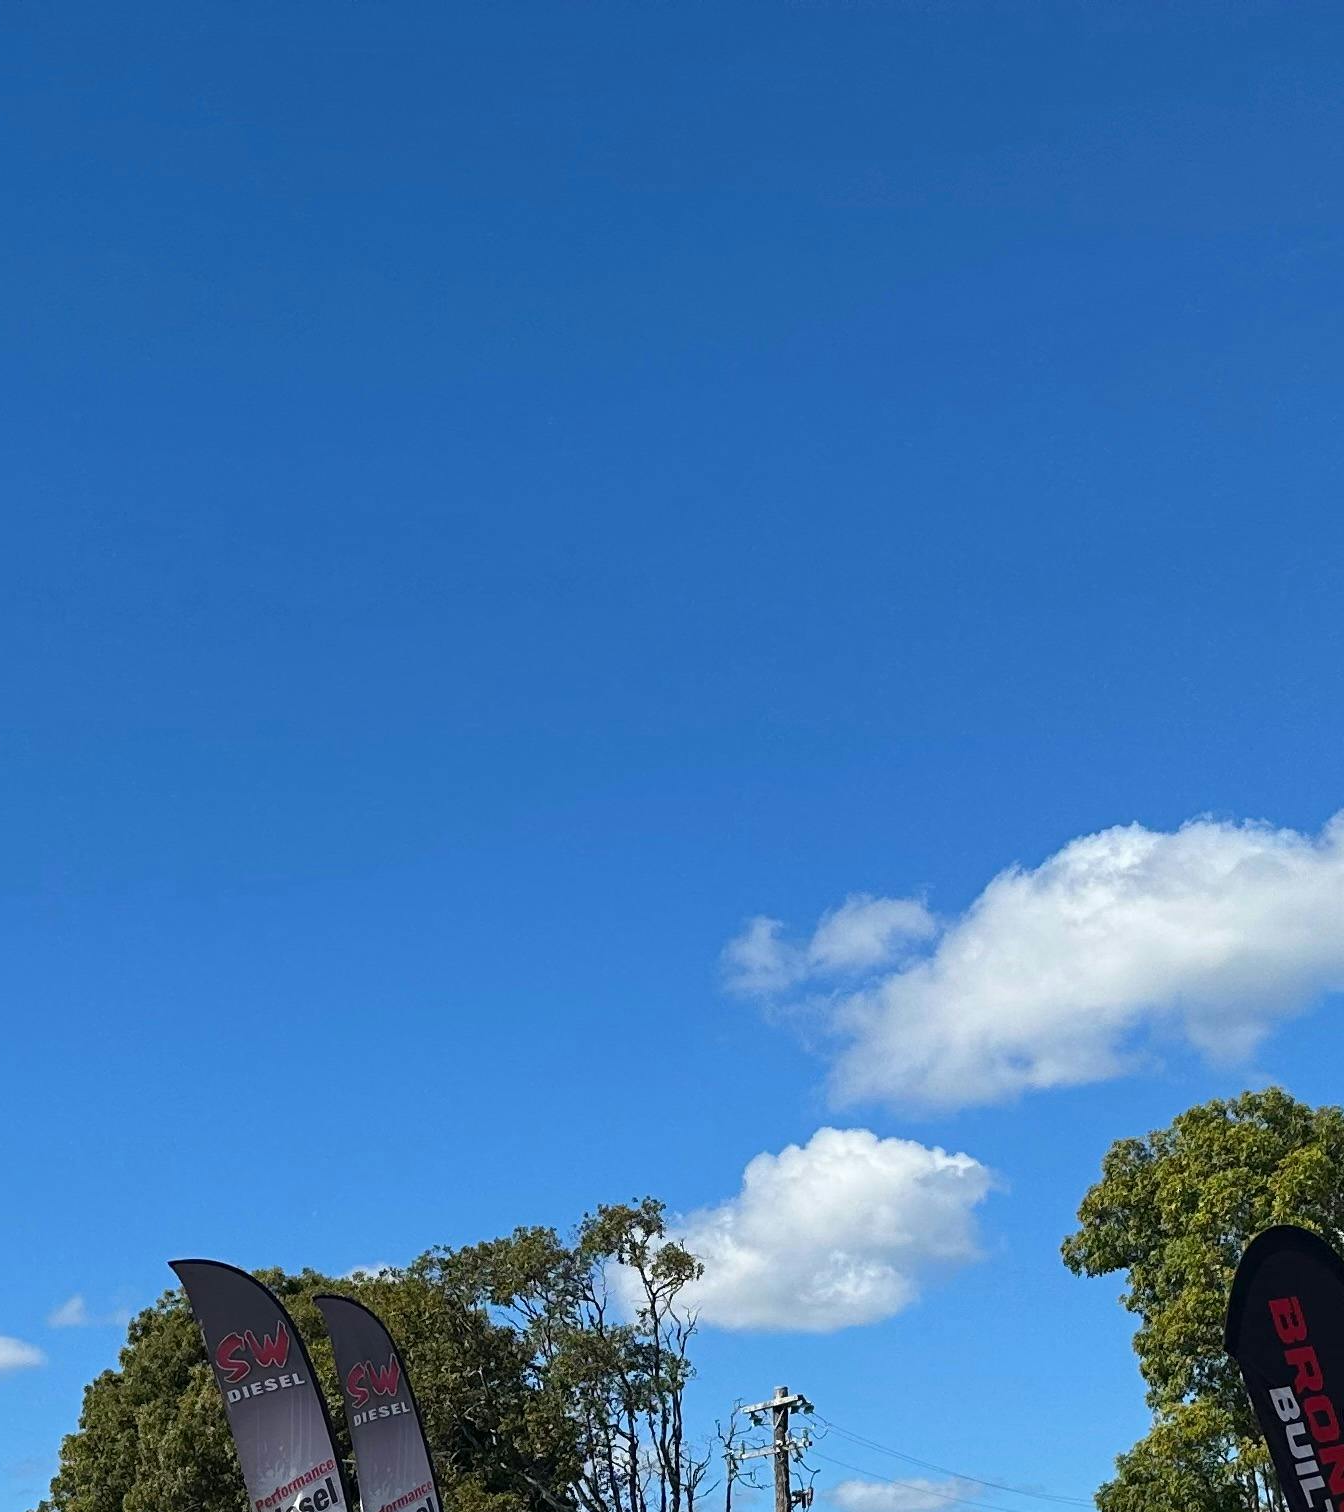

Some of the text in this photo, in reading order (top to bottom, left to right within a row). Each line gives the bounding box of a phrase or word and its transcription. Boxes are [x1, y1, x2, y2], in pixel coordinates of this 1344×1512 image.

[216, 1321, 290, 1383] SW
[228, 1375, 305, 1403] DIESEL
[346, 1354, 401, 1408] SW
[354, 1401, 411, 1427] DIESEL
[256, 1459, 335, 1512] Performance
